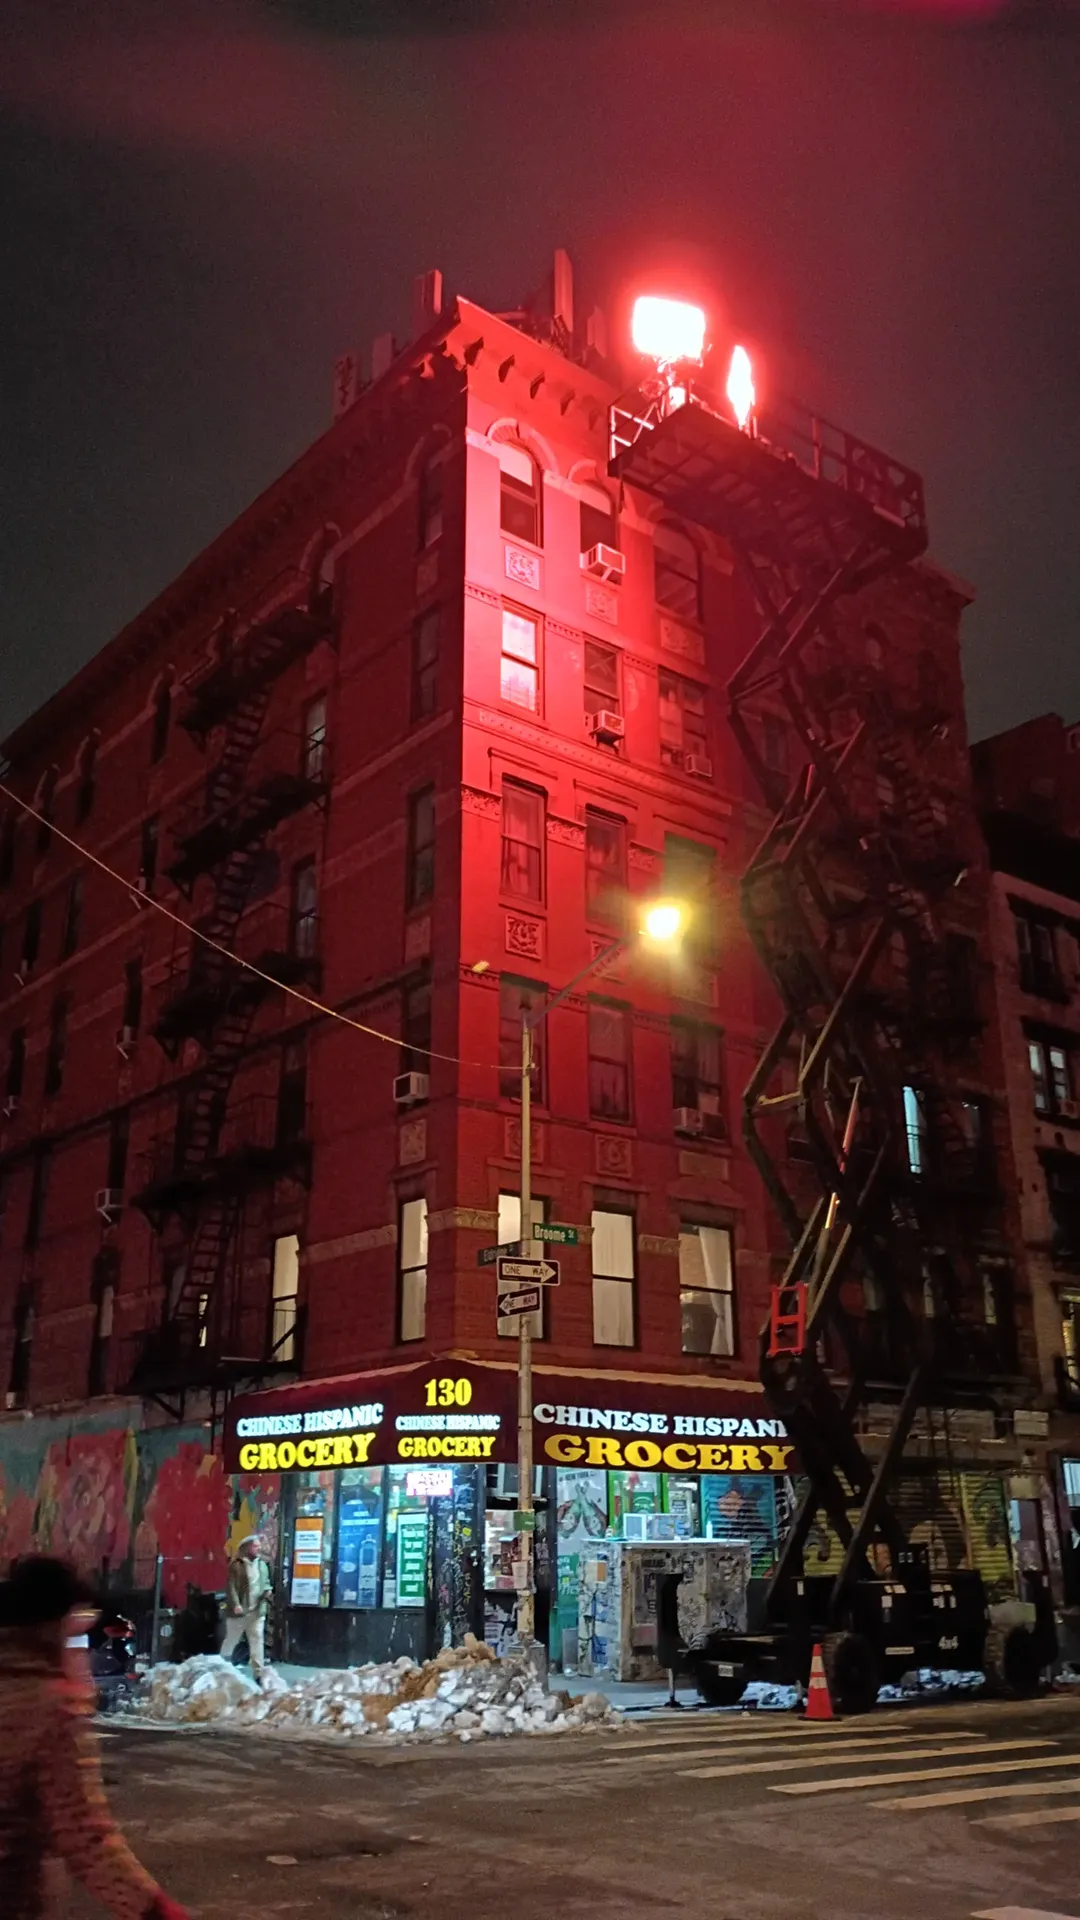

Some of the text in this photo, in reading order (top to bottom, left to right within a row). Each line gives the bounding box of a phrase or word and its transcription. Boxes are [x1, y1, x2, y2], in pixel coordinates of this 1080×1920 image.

[534, 1224, 575, 1242] Broome St
[504, 1264, 549, 1276] ONE WAY
[503, 1295, 535, 1309] ONE WAY
[425, 1378, 472, 1406] 130
[237, 1403, 383, 1436] CHINESE HISPANIC
[395, 1414, 500, 1430] CHINESE HISPANIC
[533, 1403, 788, 1437] CHINESE HISPANI
[240, 1432, 376, 1470] GROCERY
[398, 1436, 496, 1457] GROCERY
[544, 1434, 795, 1471] GROCERY
